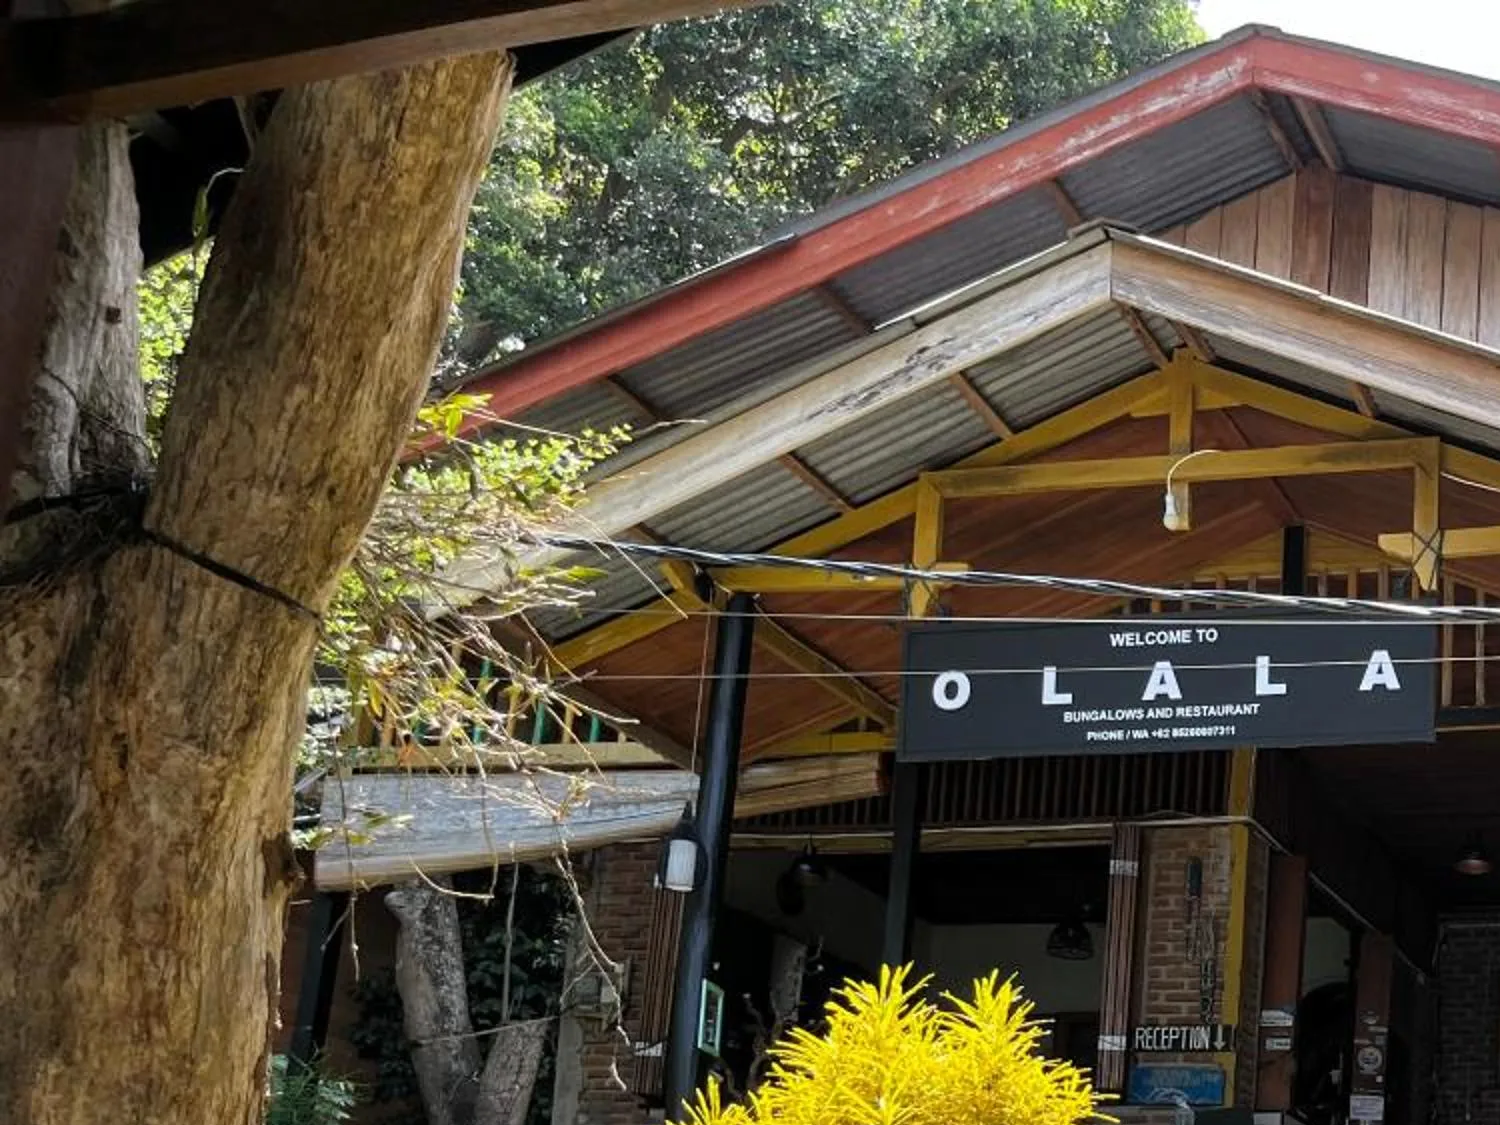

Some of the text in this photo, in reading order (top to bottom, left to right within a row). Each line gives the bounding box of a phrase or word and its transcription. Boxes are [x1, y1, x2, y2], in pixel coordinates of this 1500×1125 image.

[1110, 628, 1219, 647] WELCOME TO
[1063, 703, 1261, 723] BUNGALOWS AND RESTAURANT
[1087, 730, 1125, 741] PHONE
[1132, 729, 1149, 740] WA
[1135, 1026, 1211, 1050] RECEPTION
